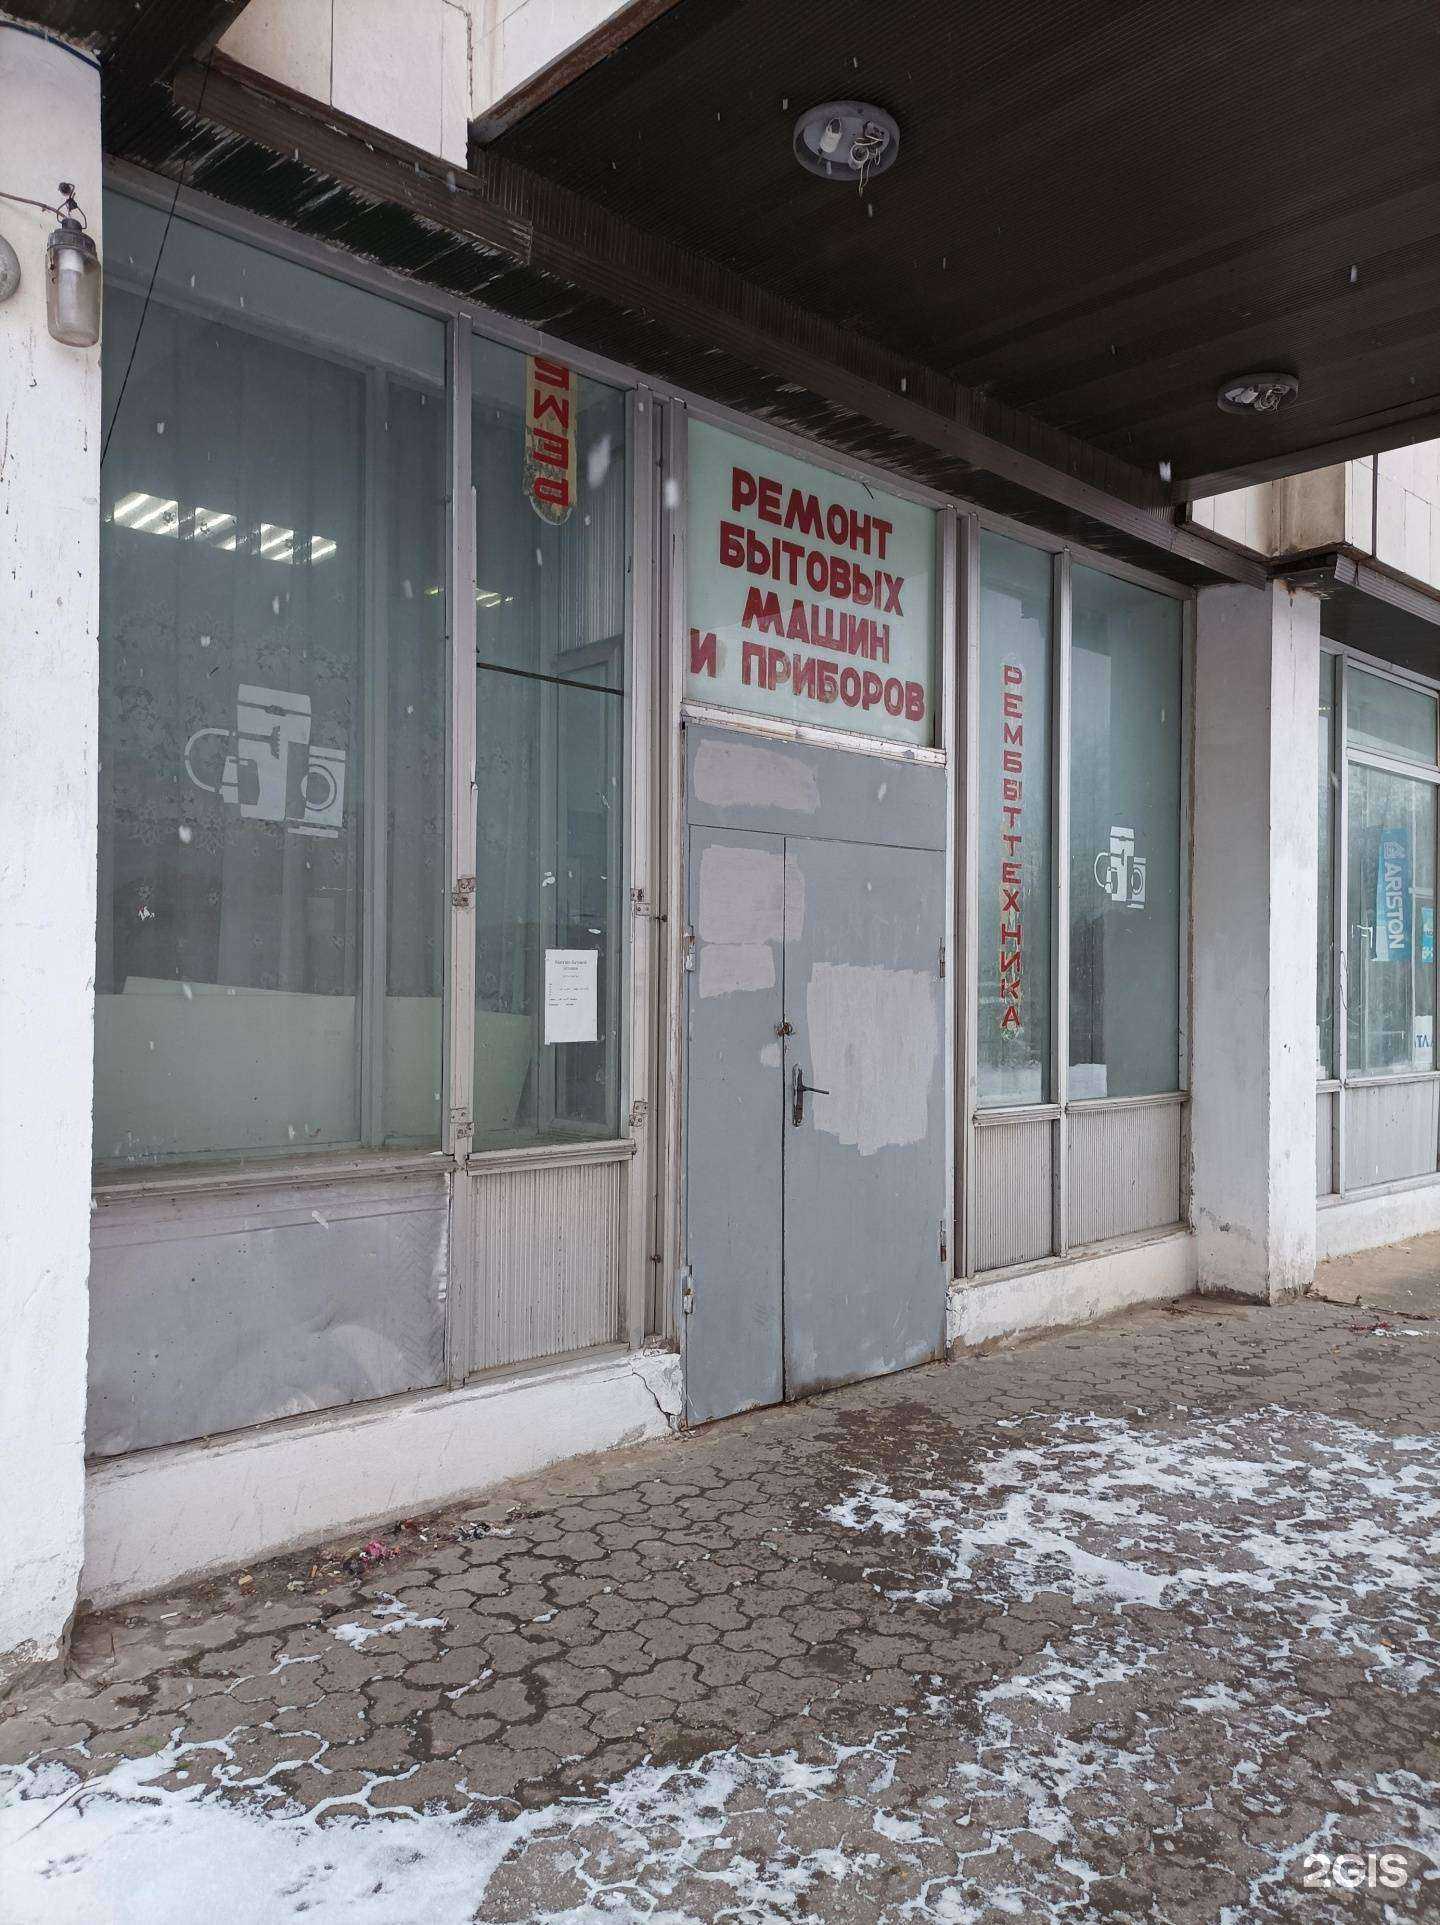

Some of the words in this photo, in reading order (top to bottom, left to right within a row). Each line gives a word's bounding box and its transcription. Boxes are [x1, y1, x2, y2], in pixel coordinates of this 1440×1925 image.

[731, 466, 892, 560] РЕМОНТ
[720, 520, 904, 617] БЫТОВЫХ
[741, 586, 890, 664] МАШИН
[690, 627, 717, 678] И
[742, 640, 925, 721] ПРИБОРОВ
[1000, 664, 1023, 1029] РЕМБЫТТЕХНИКА
[1384, 862, 1405, 949] ARISTON
